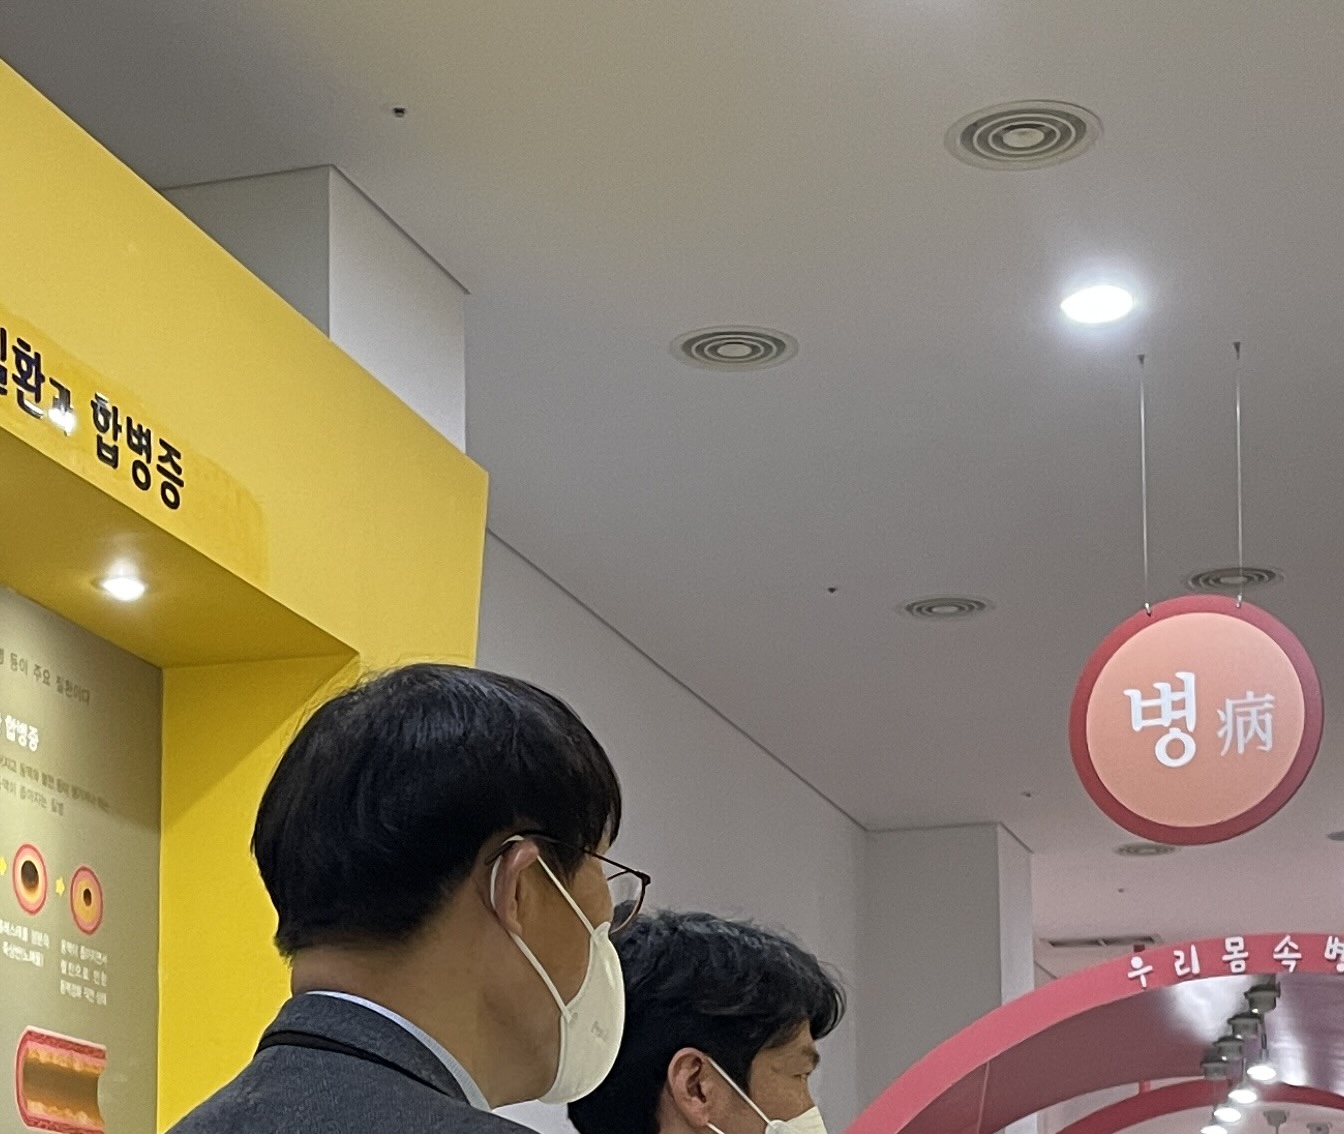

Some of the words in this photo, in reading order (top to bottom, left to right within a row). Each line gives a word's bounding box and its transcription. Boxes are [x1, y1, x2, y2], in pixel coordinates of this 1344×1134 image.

[90, 393, 186, 511] 합병증
[9, 651, 29, 677] 등이
[32, 662, 52, 687] 주요
[5, 713, 40, 752] 합병증
[1123, 670, 1198, 768] 병
[1216, 690, 1276, 757] 病
